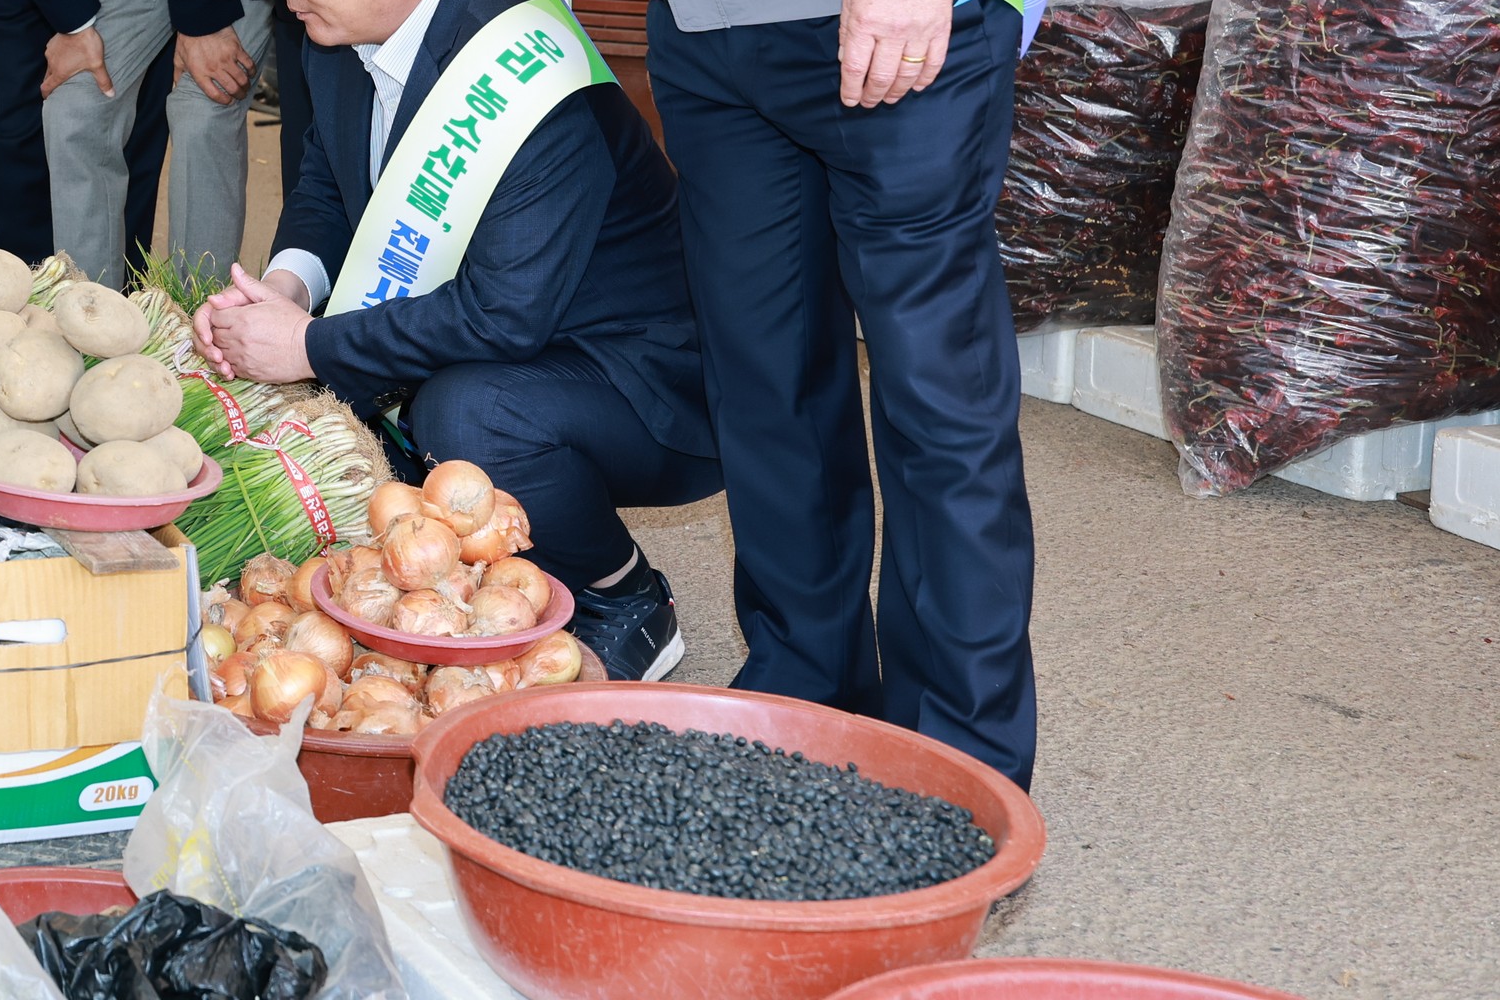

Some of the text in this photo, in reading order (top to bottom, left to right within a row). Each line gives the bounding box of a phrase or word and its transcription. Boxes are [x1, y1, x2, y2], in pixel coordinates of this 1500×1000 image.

[495, 29, 565, 85] 우리
[640, 626, 656, 650] HILFIGER
[93, 783, 140, 804] 20kg
